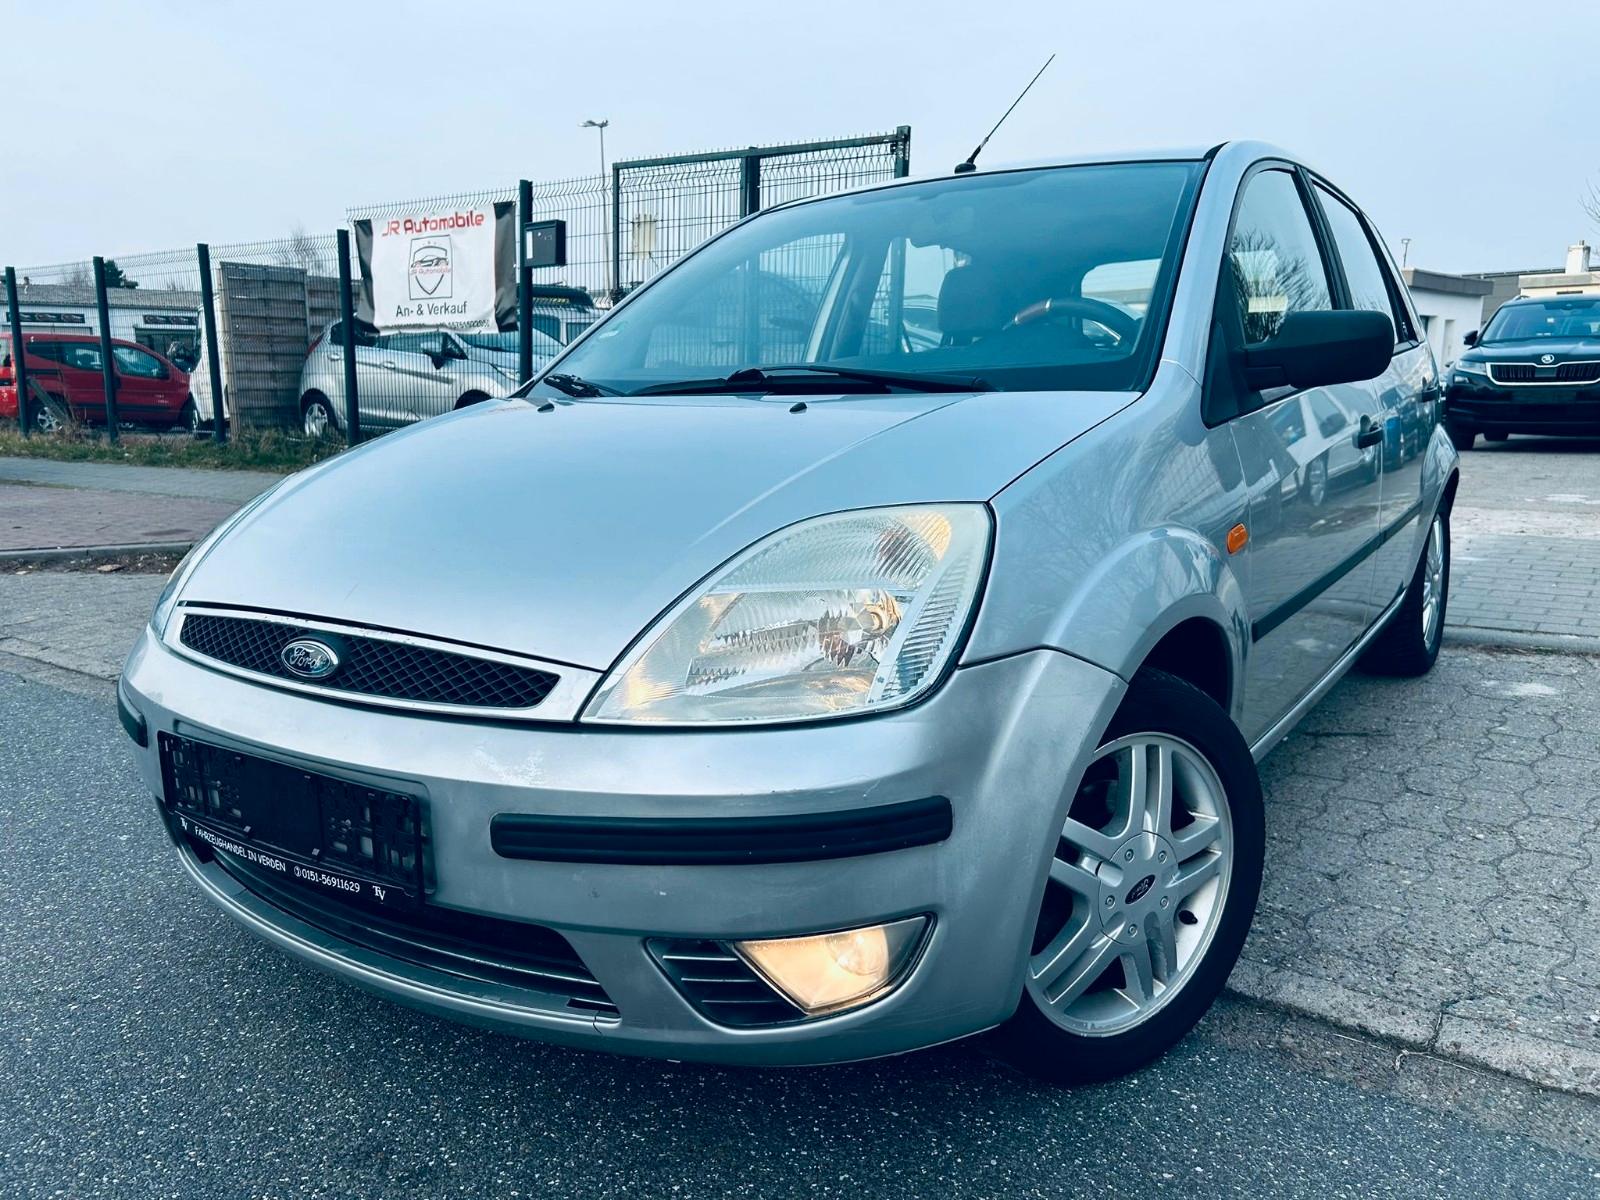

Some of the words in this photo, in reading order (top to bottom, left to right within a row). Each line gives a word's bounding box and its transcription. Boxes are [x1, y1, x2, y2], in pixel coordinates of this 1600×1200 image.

[382, 220, 401, 237] JR
[403, 210, 485, 234] Automobile
[396, 304, 414, 317] An-
[416, 303, 424, 316] &
[427, 300, 468, 316] Verkauf
[289, 645, 329, 670] Ford
[194, 826, 248, 859] FAHRZEUGHANDEL
[247, 849, 258, 862] IN
[257, 853, 286, 872] VERDEN
